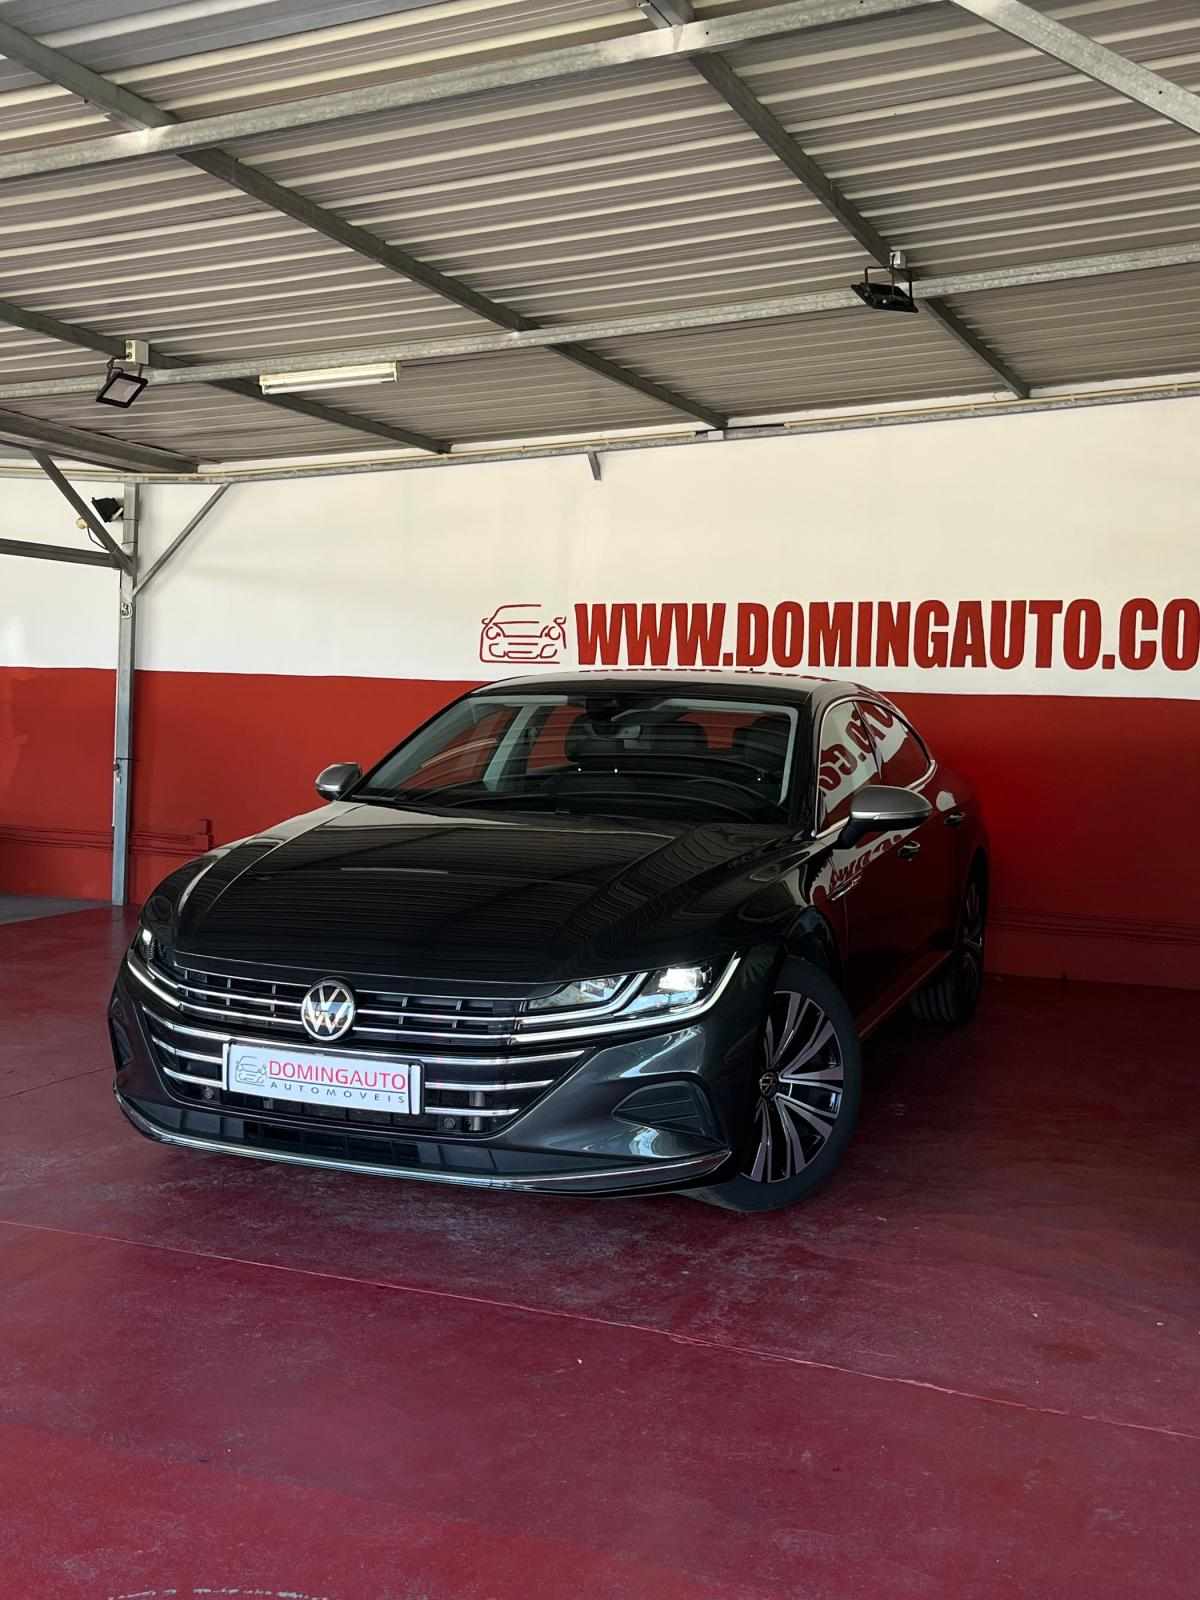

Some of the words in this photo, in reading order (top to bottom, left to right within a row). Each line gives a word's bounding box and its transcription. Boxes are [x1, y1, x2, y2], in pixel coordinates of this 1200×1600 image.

[574, 598, 1200, 671] WWW.DOMINGAUTO.CO
[302, 980, 354, 1040] VW
[268, 1060, 406, 1090] DOMINGAUTO
